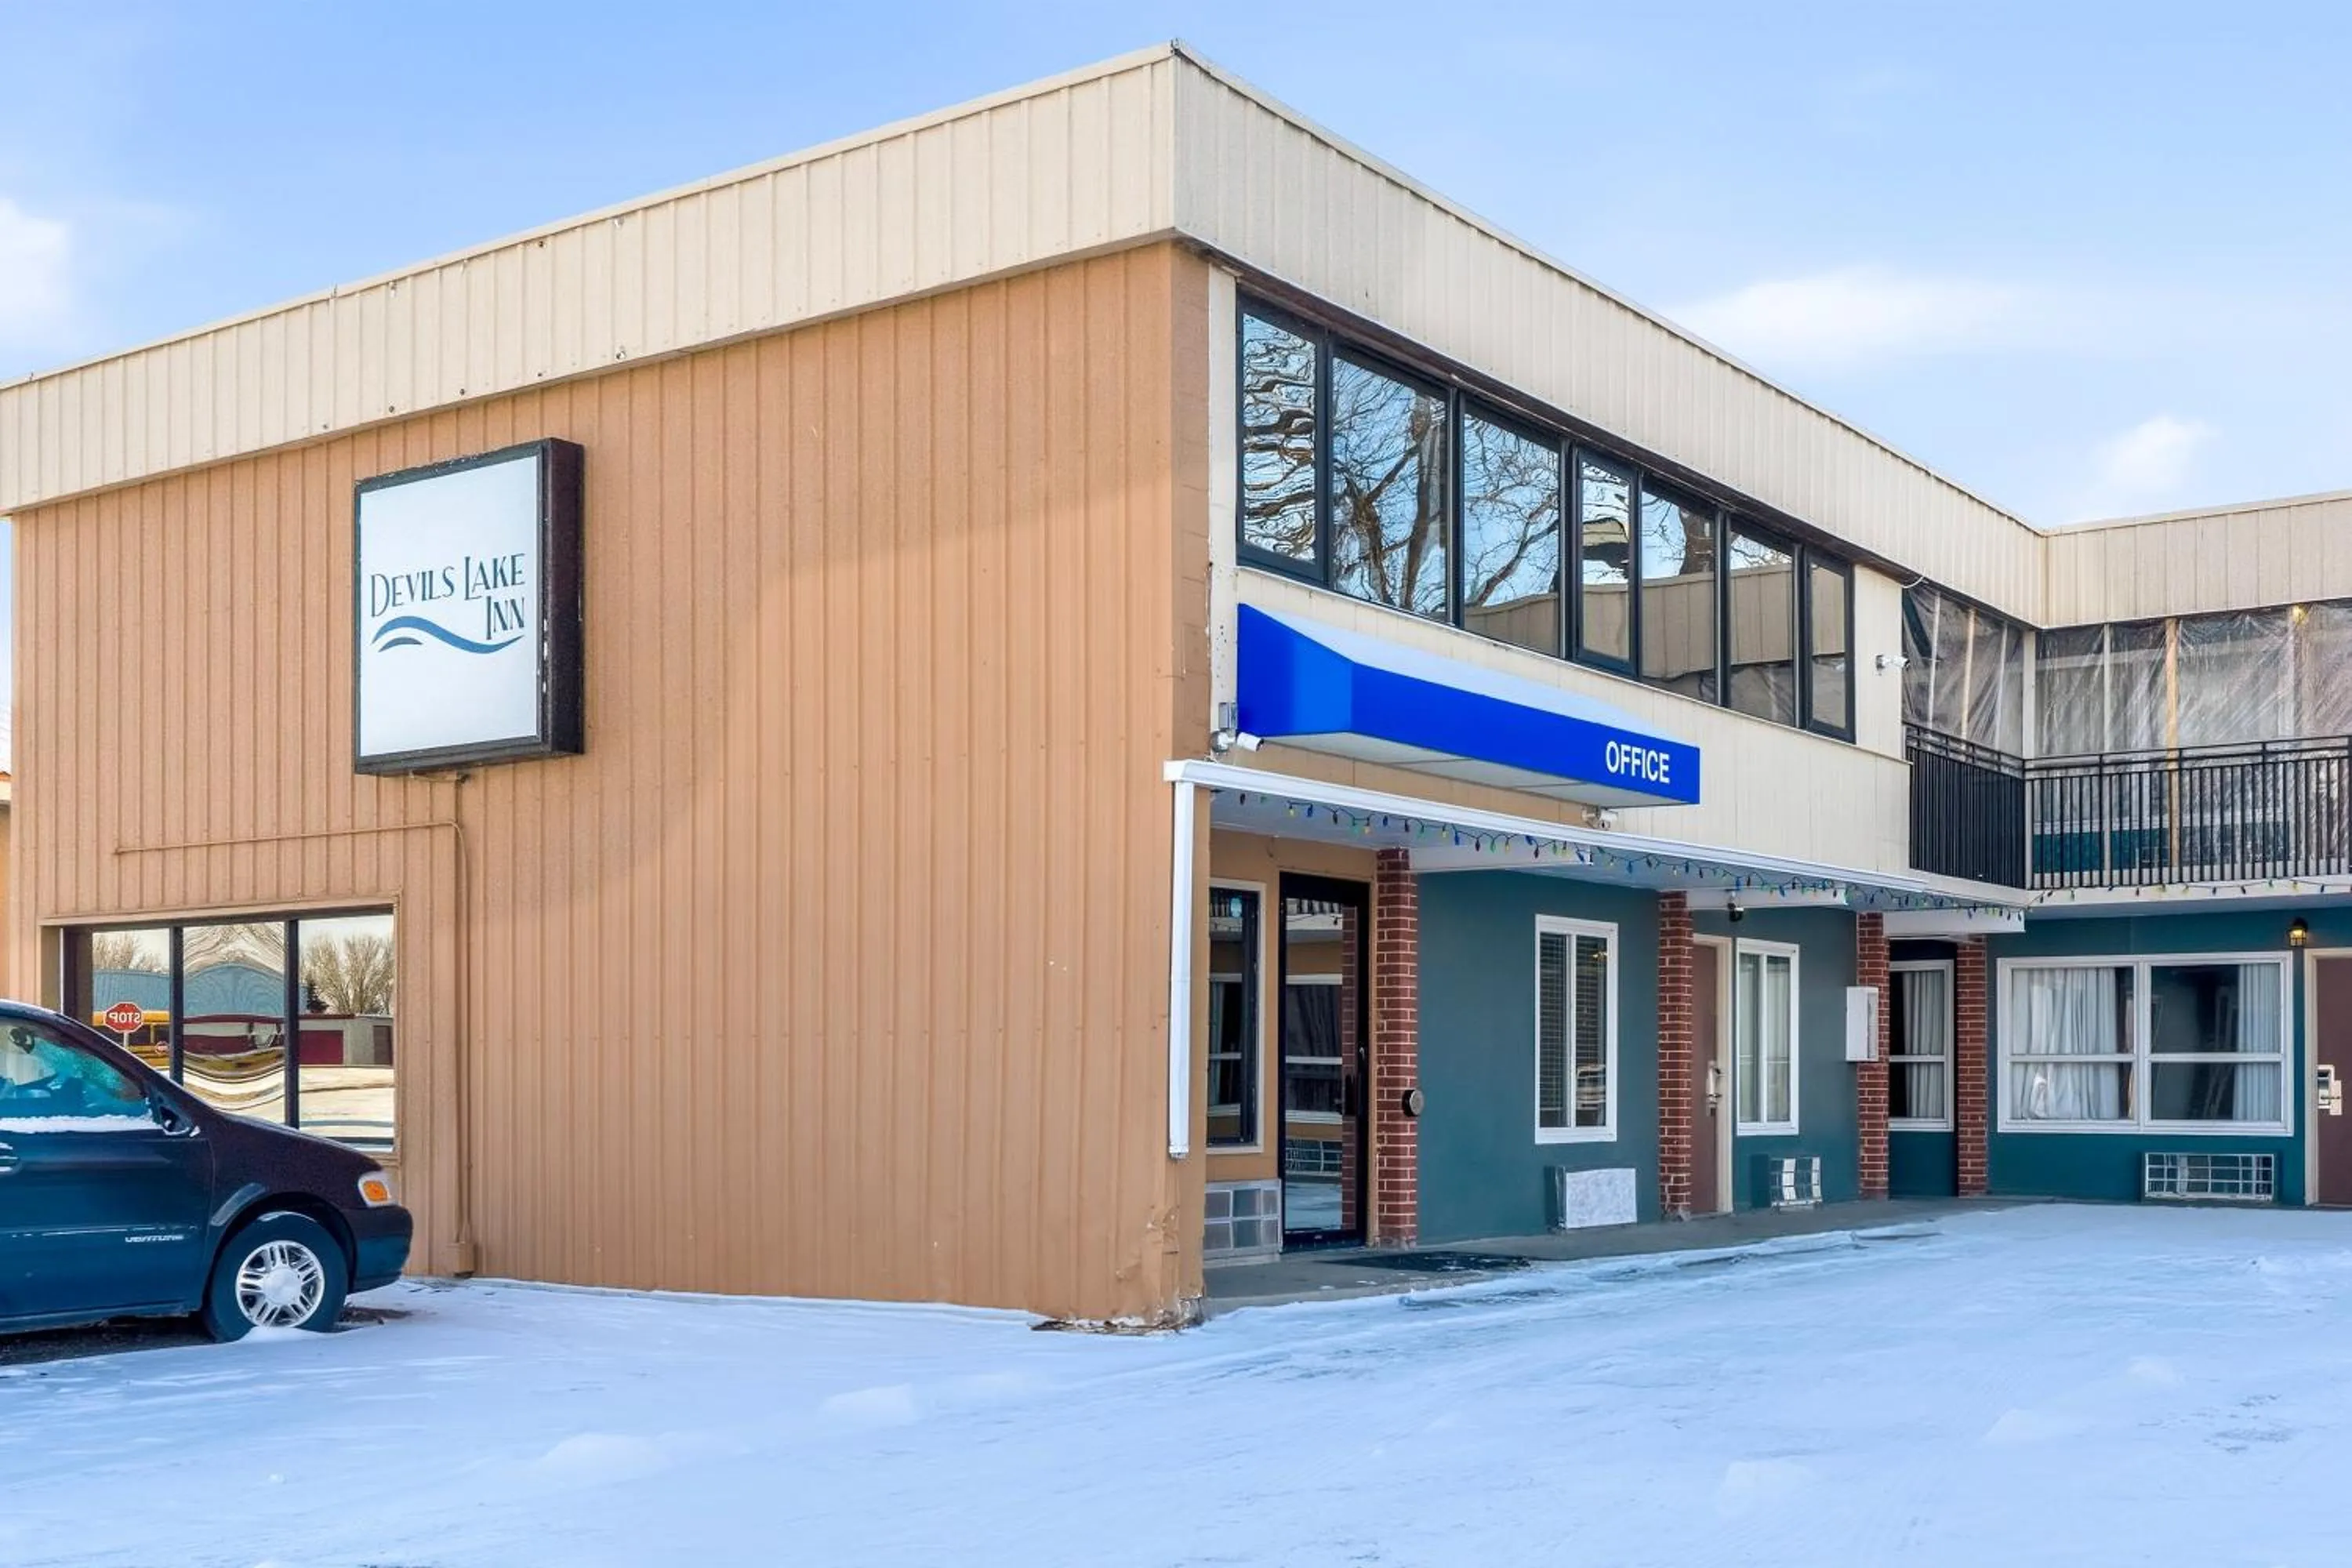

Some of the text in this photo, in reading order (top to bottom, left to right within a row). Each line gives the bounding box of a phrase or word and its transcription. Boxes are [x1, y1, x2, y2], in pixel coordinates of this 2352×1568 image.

[371, 553, 525, 618] DEVILS LAKE
[486, 595, 525, 641] INN
[1606, 740, 1671, 784] OFFICE
